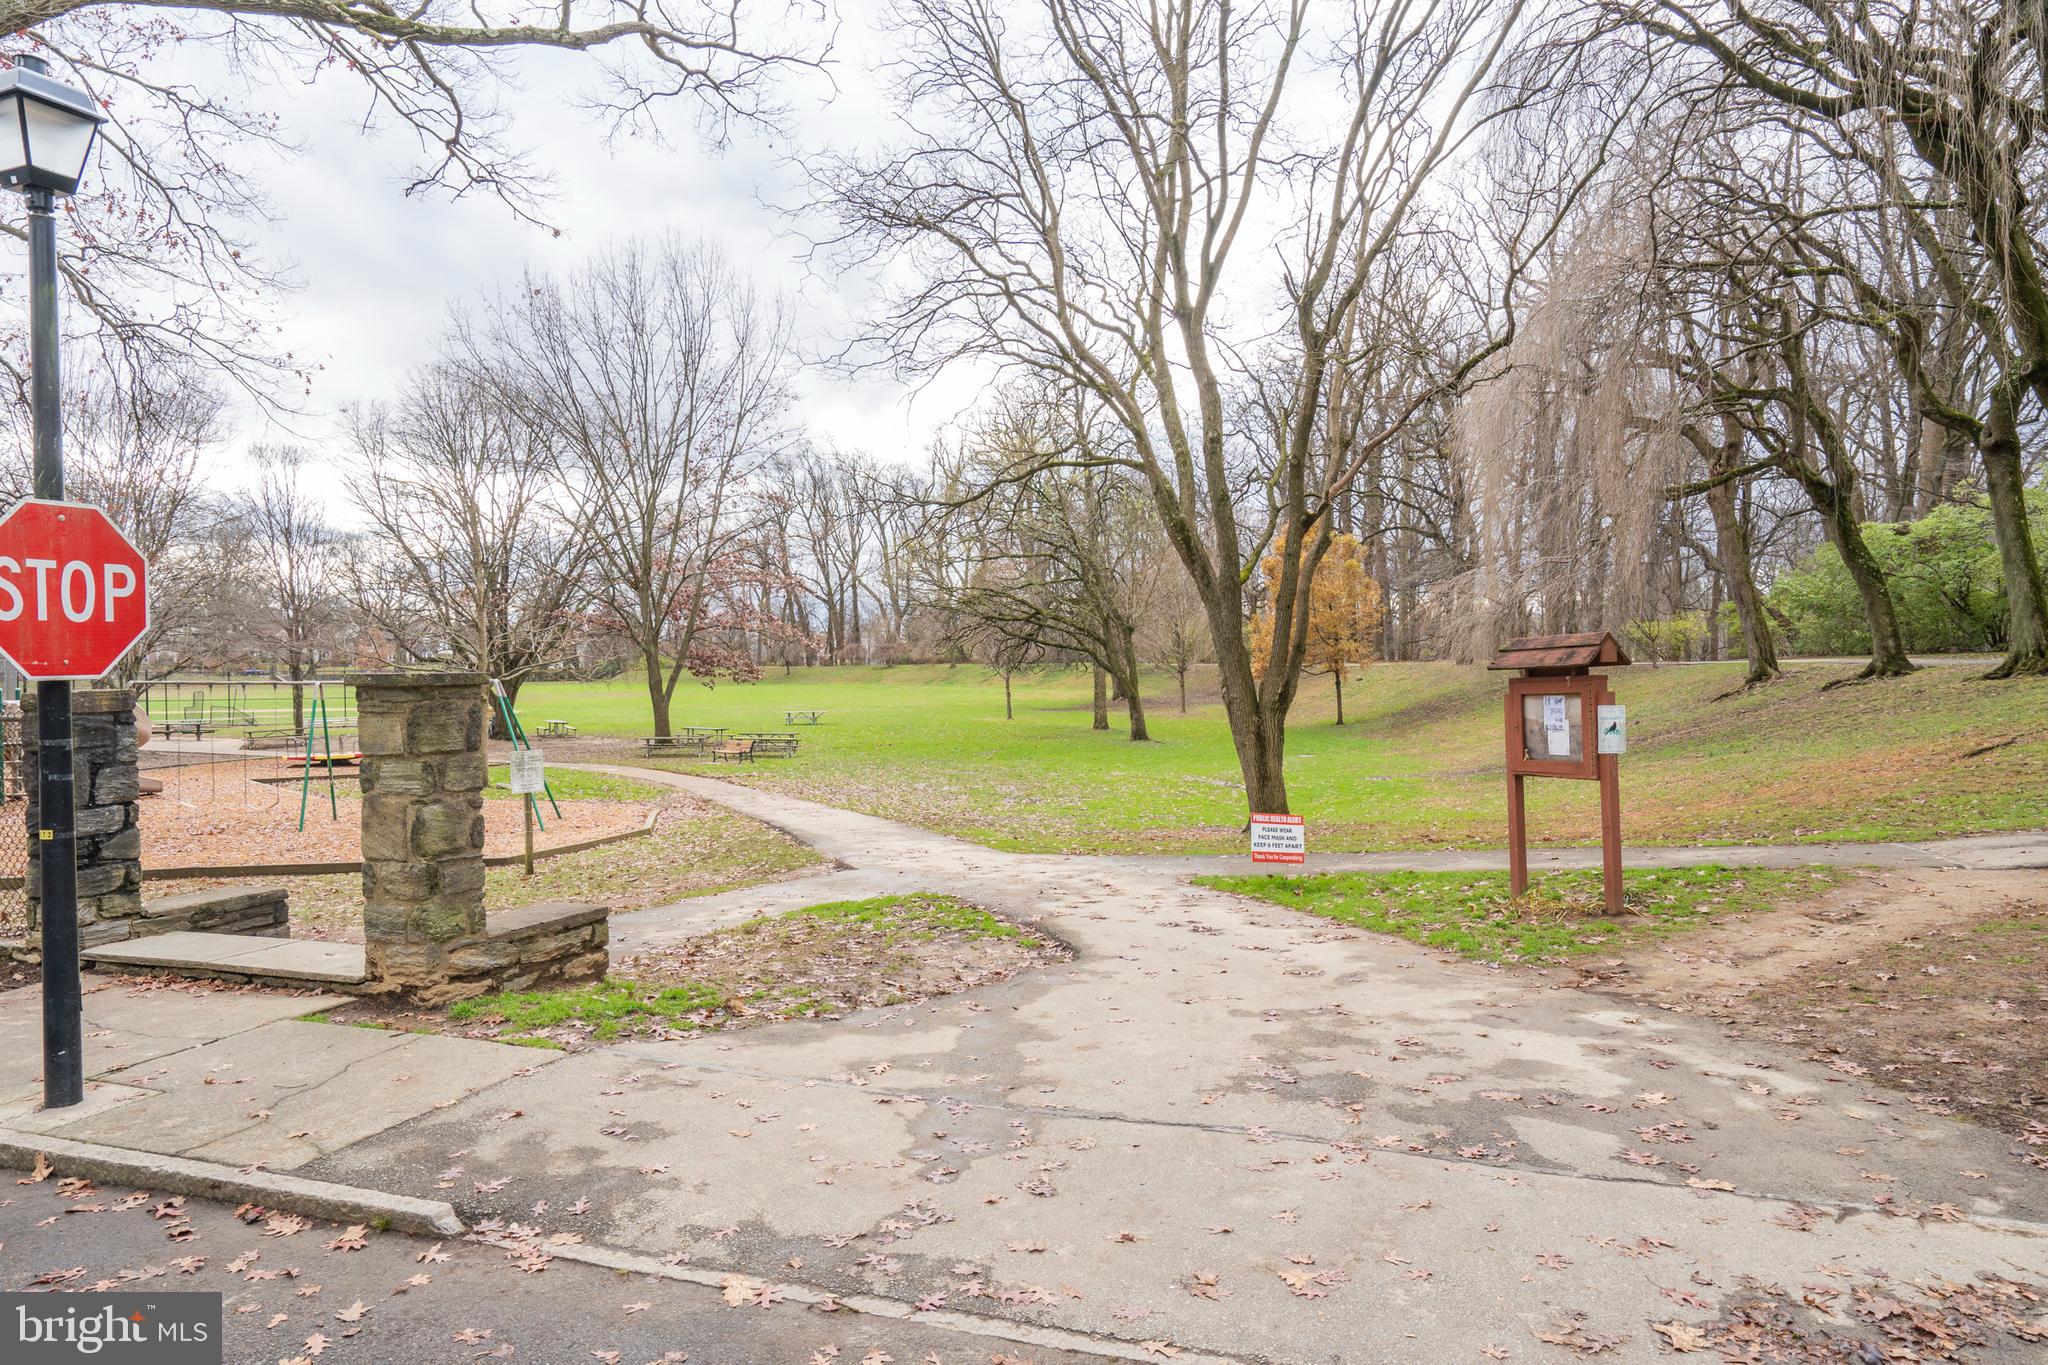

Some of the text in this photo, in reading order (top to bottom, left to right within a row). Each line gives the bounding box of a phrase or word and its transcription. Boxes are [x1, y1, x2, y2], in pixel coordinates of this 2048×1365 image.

[0, 555, 137, 623] STOP
[1270, 815, 1286, 823] HEALTH
[1287, 816, 1302, 824] ALERT
[1279, 854, 1303, 862] Cooperating
